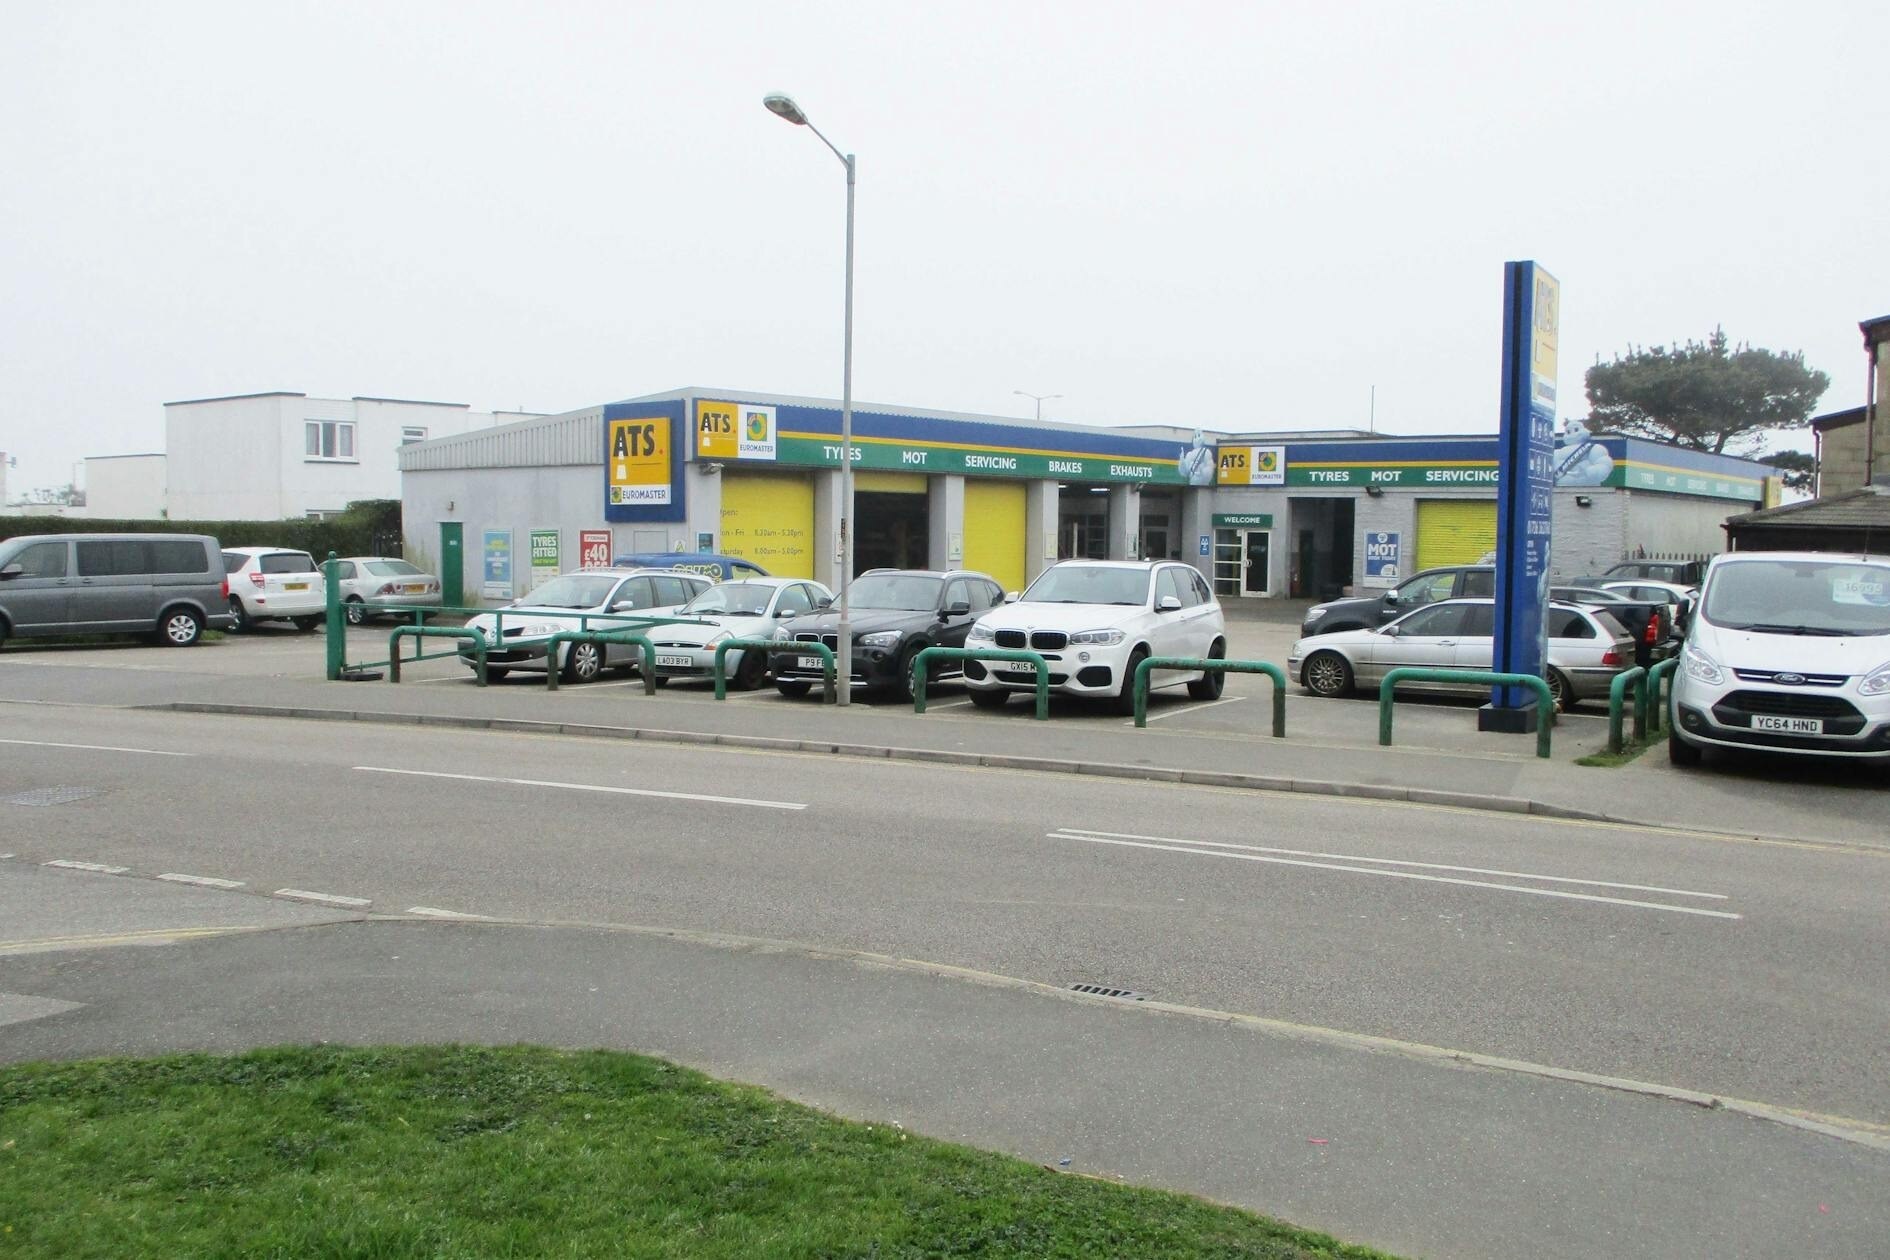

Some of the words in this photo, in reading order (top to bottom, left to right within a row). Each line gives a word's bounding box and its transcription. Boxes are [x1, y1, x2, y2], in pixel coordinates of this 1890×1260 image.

[701, 412, 731, 433] ATS
[613, 424, 655, 457] ATS
[739, 444, 773, 453] EUROMASTER
[902, 451, 928, 465] MOT
[965, 455, 1017, 470] SERVICING
[1049, 460, 1082, 474] BRAKES
[1110, 464, 1153, 478] EXHAUSTS
[1220, 454, 1245, 469] ATS
[1309, 471, 1350, 482] TYRES
[1371, 471, 1402, 482] MOT
[1426, 470, 1499, 482] SERVICING
[622, 489, 666, 500] EUROMASTER
[1224, 516, 1261, 524] WELCOME
[533, 536, 557, 547] TYRES
[533, 547, 557, 558] FITTED
[584, 543, 608, 561] £40
[1368, 543, 1397, 556] MOT
[1757, 716, 1789, 729] YC64
[1792, 719, 1818, 732] HND
